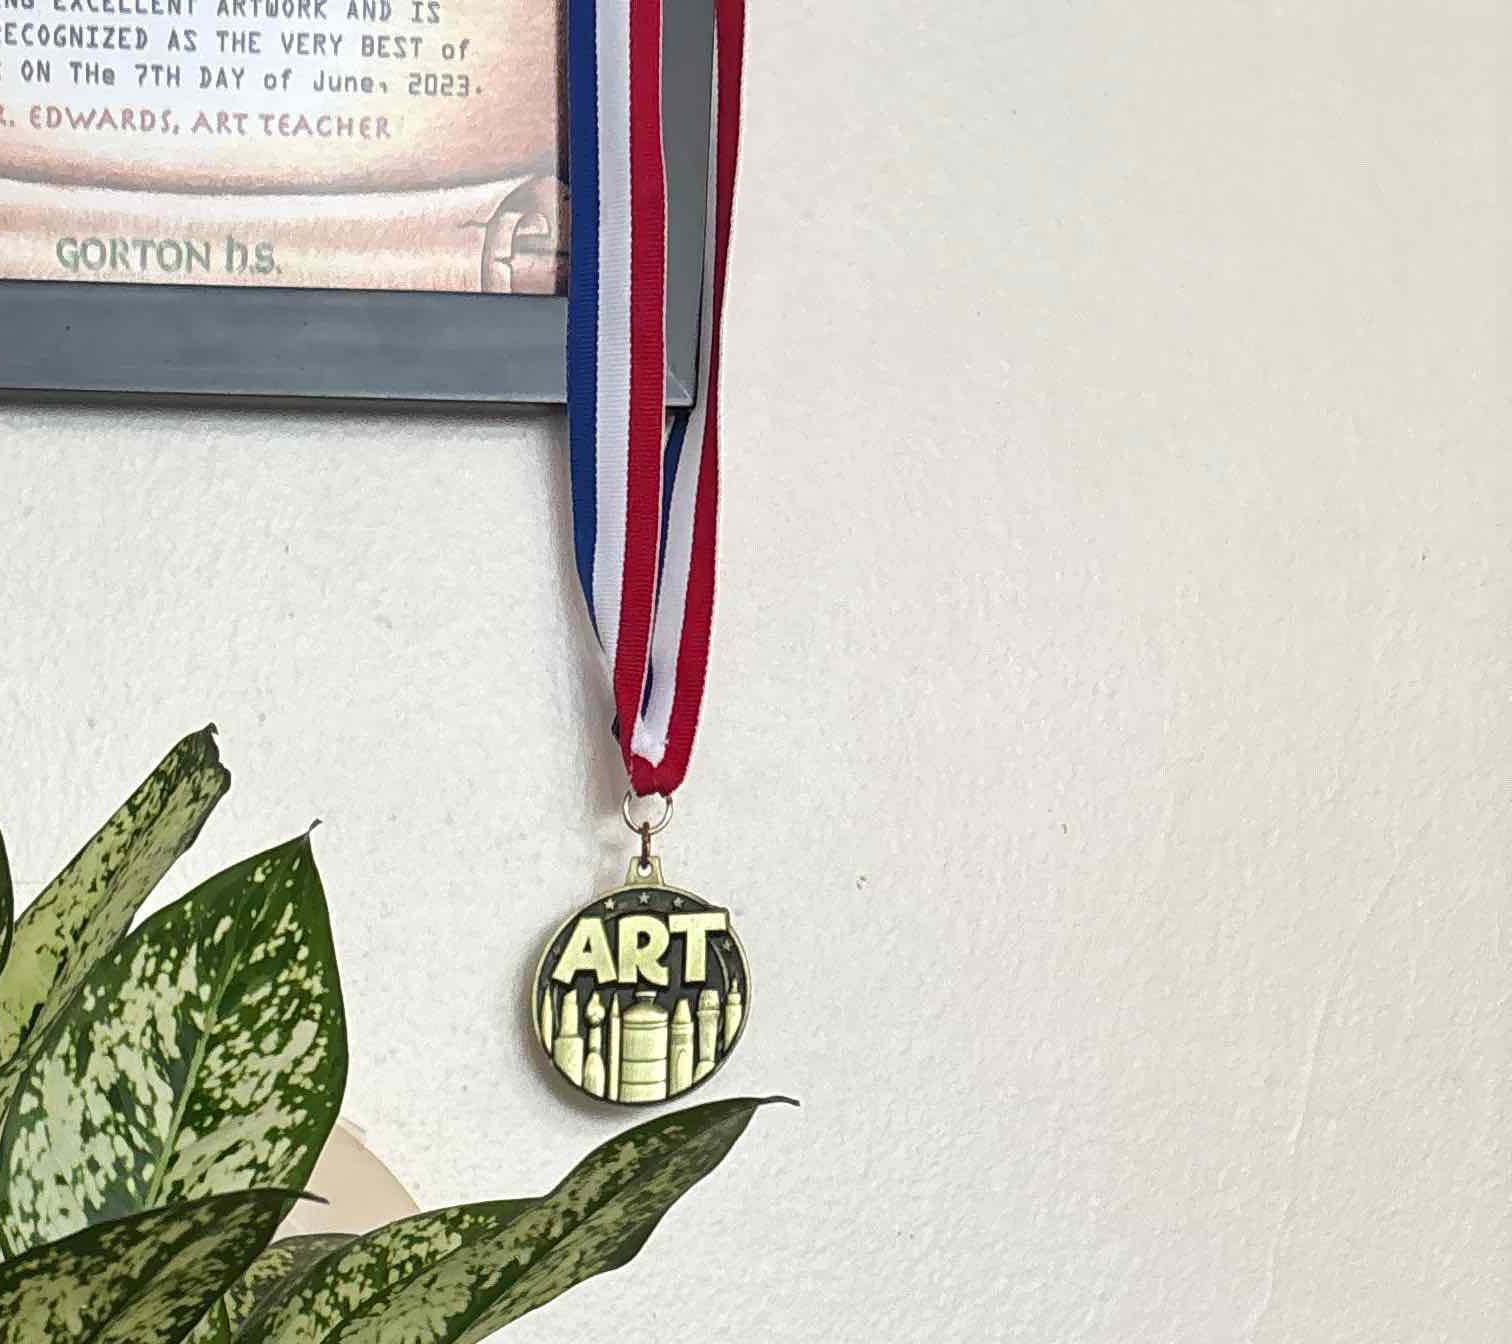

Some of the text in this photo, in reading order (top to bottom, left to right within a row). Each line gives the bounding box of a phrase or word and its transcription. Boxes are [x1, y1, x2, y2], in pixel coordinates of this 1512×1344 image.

[217, 0, 327, 19] ARTWORK
[347, 0, 391, 21] AND
[412, 0, 440, 23] IS
[168, 27, 197, 51] AS
[216, 30, 261, 53] THE
[281, 32, 342, 56] VERY
[361, 34, 423, 58] BEST
[441, 38, 470, 60] of
[21, 60, 50, 82] ON
[135, 64, 180, 88] 7TH
[200, 66, 244, 90] DAY
[264, 68, 292, 91] of
[313, 70, 387, 94] June,
[408, 72, 482, 97] 2023.
[29, 105, 179, 135] EDWARDS,
[191, 110, 248, 135] ART
[258, 113, 390, 139] TEACHER
[56, 237, 211, 272] GORTON
[552, 912, 727, 986] ART
